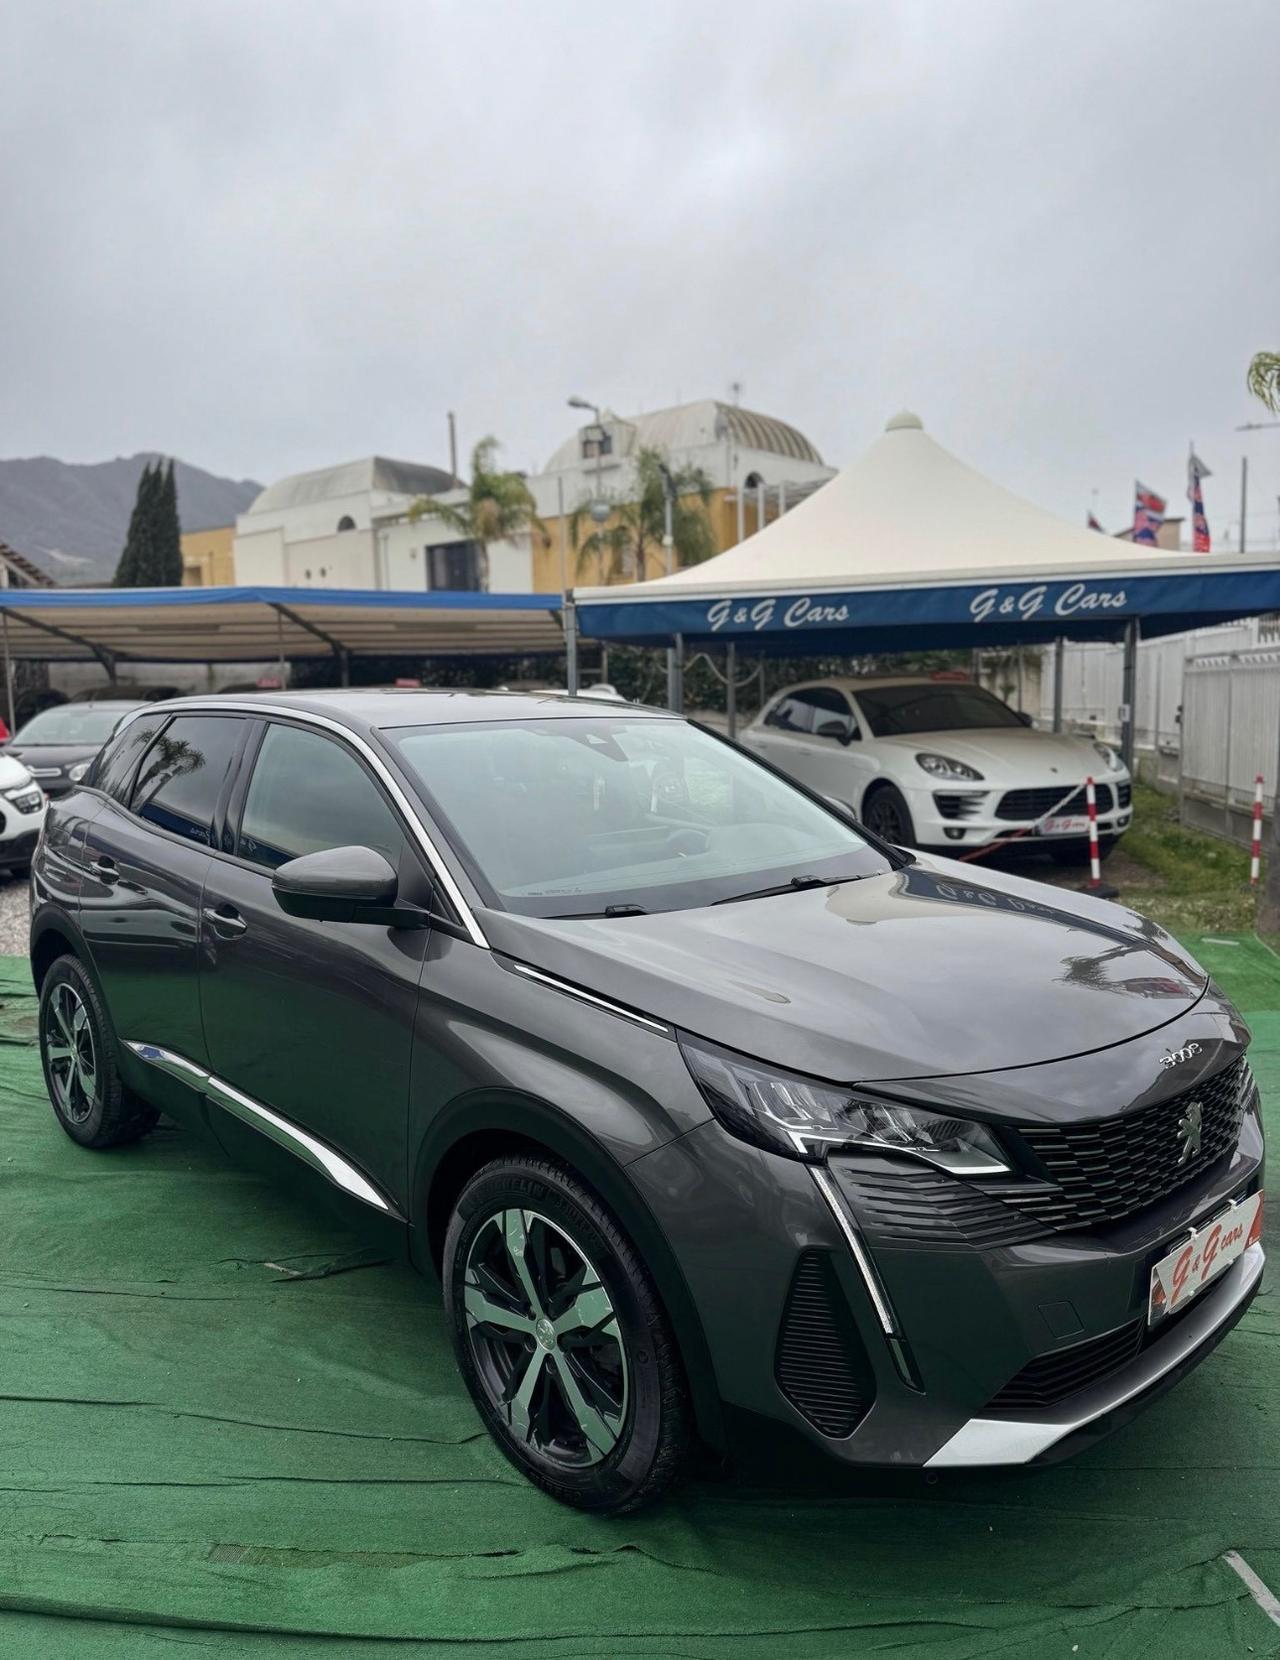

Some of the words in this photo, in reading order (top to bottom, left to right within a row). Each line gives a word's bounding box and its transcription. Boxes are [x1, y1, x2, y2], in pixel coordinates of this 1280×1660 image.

[707, 599, 776, 632] G&G
[783, 597, 849, 628] Cars
[969, 585, 1047, 623] G&G
[1054, 583, 1127, 616] Cars
[1159, 1042, 1203, 1070] 3008
[1220, 1223, 1244, 1251] cars
